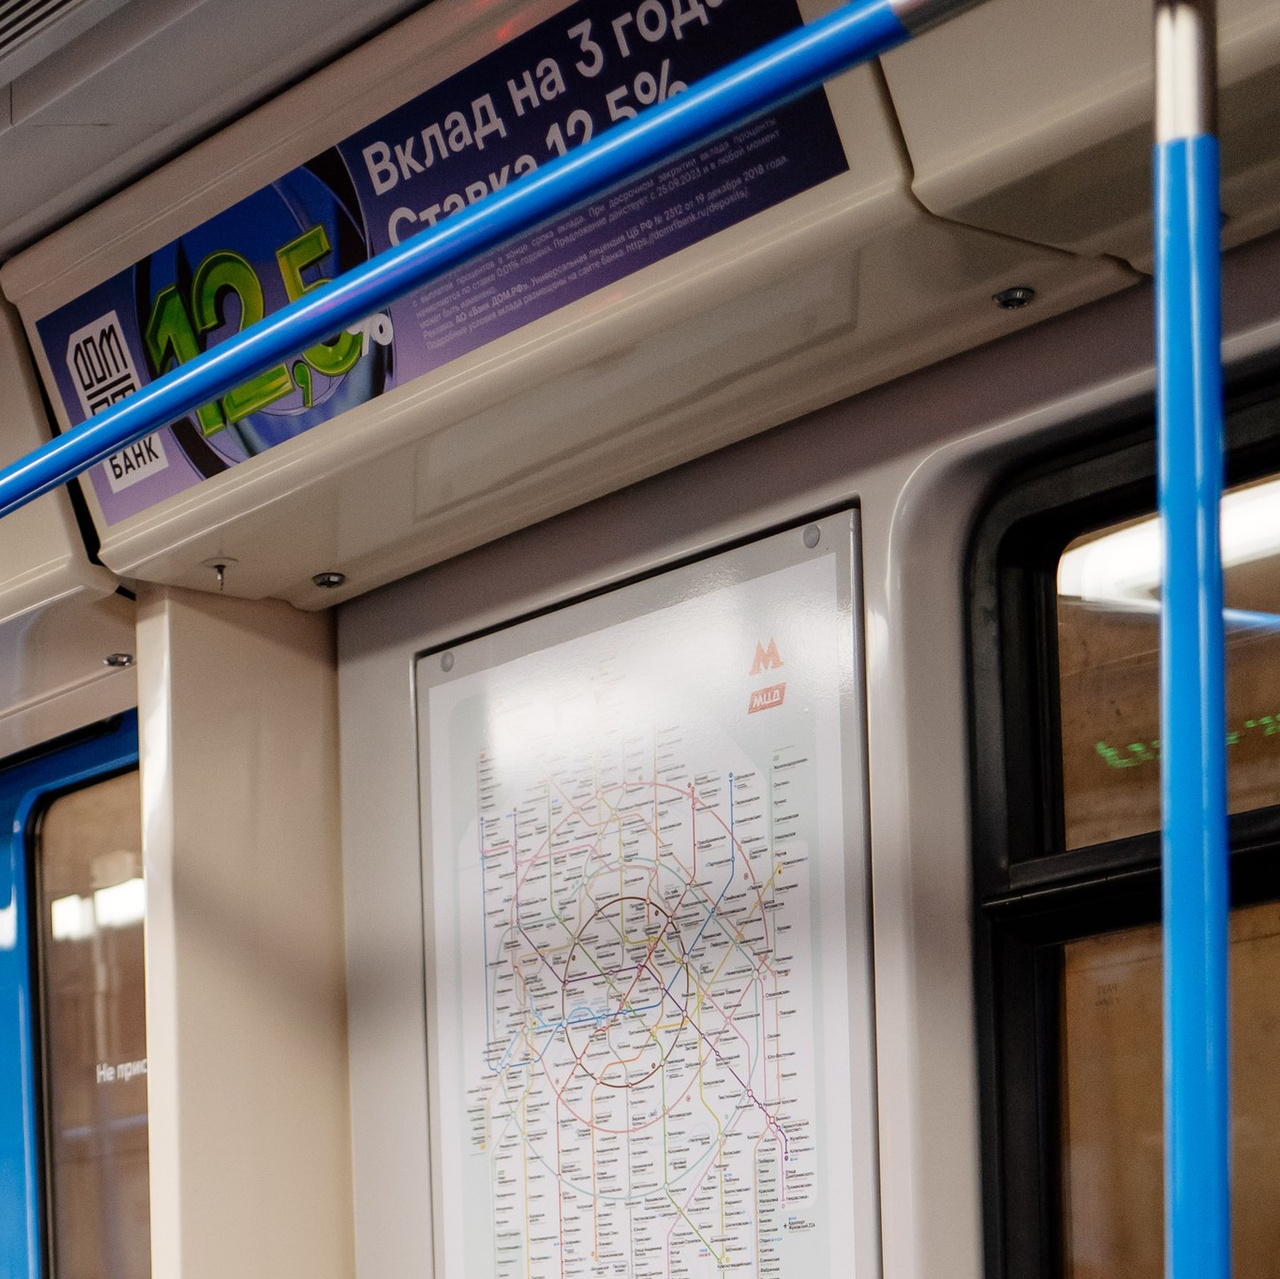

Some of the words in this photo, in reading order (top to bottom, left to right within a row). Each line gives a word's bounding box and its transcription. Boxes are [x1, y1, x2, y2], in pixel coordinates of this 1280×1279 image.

[362, 93, 507, 196] Вклад
[507, 57, 567, 116] на
[567, 18, 604, 78] 3
[611, 0, 722, 58] год
[109, 437, 159, 480] БАНК
[96, 1063, 115, 1083] Не
